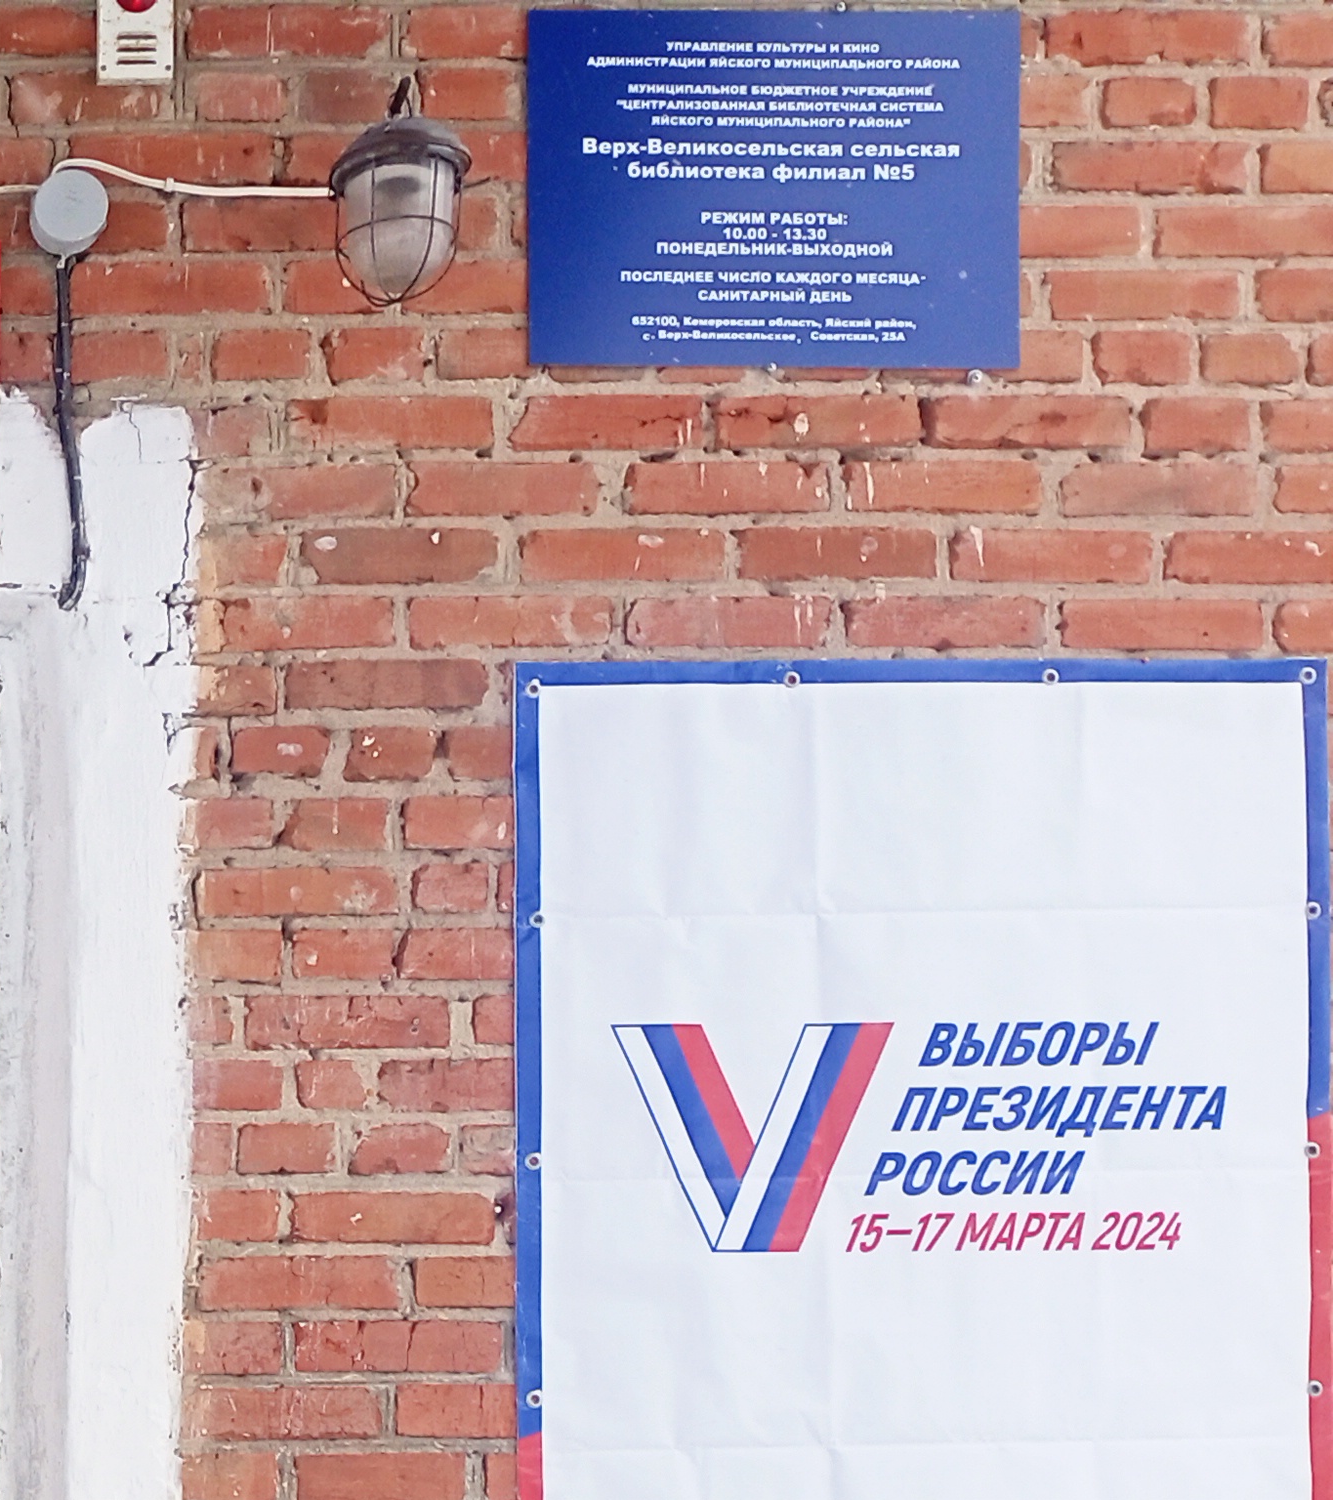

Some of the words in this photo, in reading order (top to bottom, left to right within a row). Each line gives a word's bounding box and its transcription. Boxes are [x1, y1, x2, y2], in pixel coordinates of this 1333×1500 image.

[666, 42, 753, 53] УПРАВЛЕНИЕ
[757, 42, 826, 53] КУЛЬТУРЫ
[830, 43, 839, 53] И
[843, 42, 880, 53] КИНО
[587, 57, 706, 68] АДМИНИСТРАЦИИ
[709, 56, 770, 69] ЯЙСКОГО
[774, 59, 902, 70] МУНИЦИПАЛЬНОГО
[905, 57, 961, 69] РАЙОНА
[627, 84, 747, 96] МУНИЦИПАЛЬНОЕ
[751, 85, 838, 97] БЮДЖЕТНОЕ
[841, 85, 933, 97] УЧРЕЖДЕНИЕ
[769, 101, 876, 112] БИБЛИОТЕЧНАЯ
[880, 102, 944, 112] СИСТЕМА
[651, 114, 713, 126] ЯЙСКОГО
[717, 116, 845, 128] МУНИЦИПАЛЬНОГО
[582, 138, 843, 158] Верх-Великосельская
[850, 143, 961, 158] сельская
[627, 162, 765, 180] библиотека
[772, 165, 865, 183] филиал
[873, 165, 915, 181] №5
[701, 212, 764, 225] РЕЖИМ
[770, 213, 848, 225] РАБОТЫ:
[723, 228, 767, 240] 10.00
[783, 229, 827, 240] 13.30
[656, 242, 893, 258] ПОНЕДЕЛЬНИК-ВЫХОДНОЙ
[620, 270, 713, 283] ПОСЛЕДНЕЕ
[718, 271, 771, 283] ЧИСЛО
[776, 272, 852, 285] КАЖДОГО
[698, 288, 805, 303] САНИТАРНЫЙ
[810, 290, 852, 304] ДЕНЬ
[918, 1021, 1160, 1068] ВЫБОРЫ
[891, 1086, 1227, 1138] ПРЕЗИДЕНТА
[864, 1151, 1085, 1196] РОССИИ
[955, 1212, 1089, 1252] МАРТА
[1091, 1212, 1183, 1252] 2024
